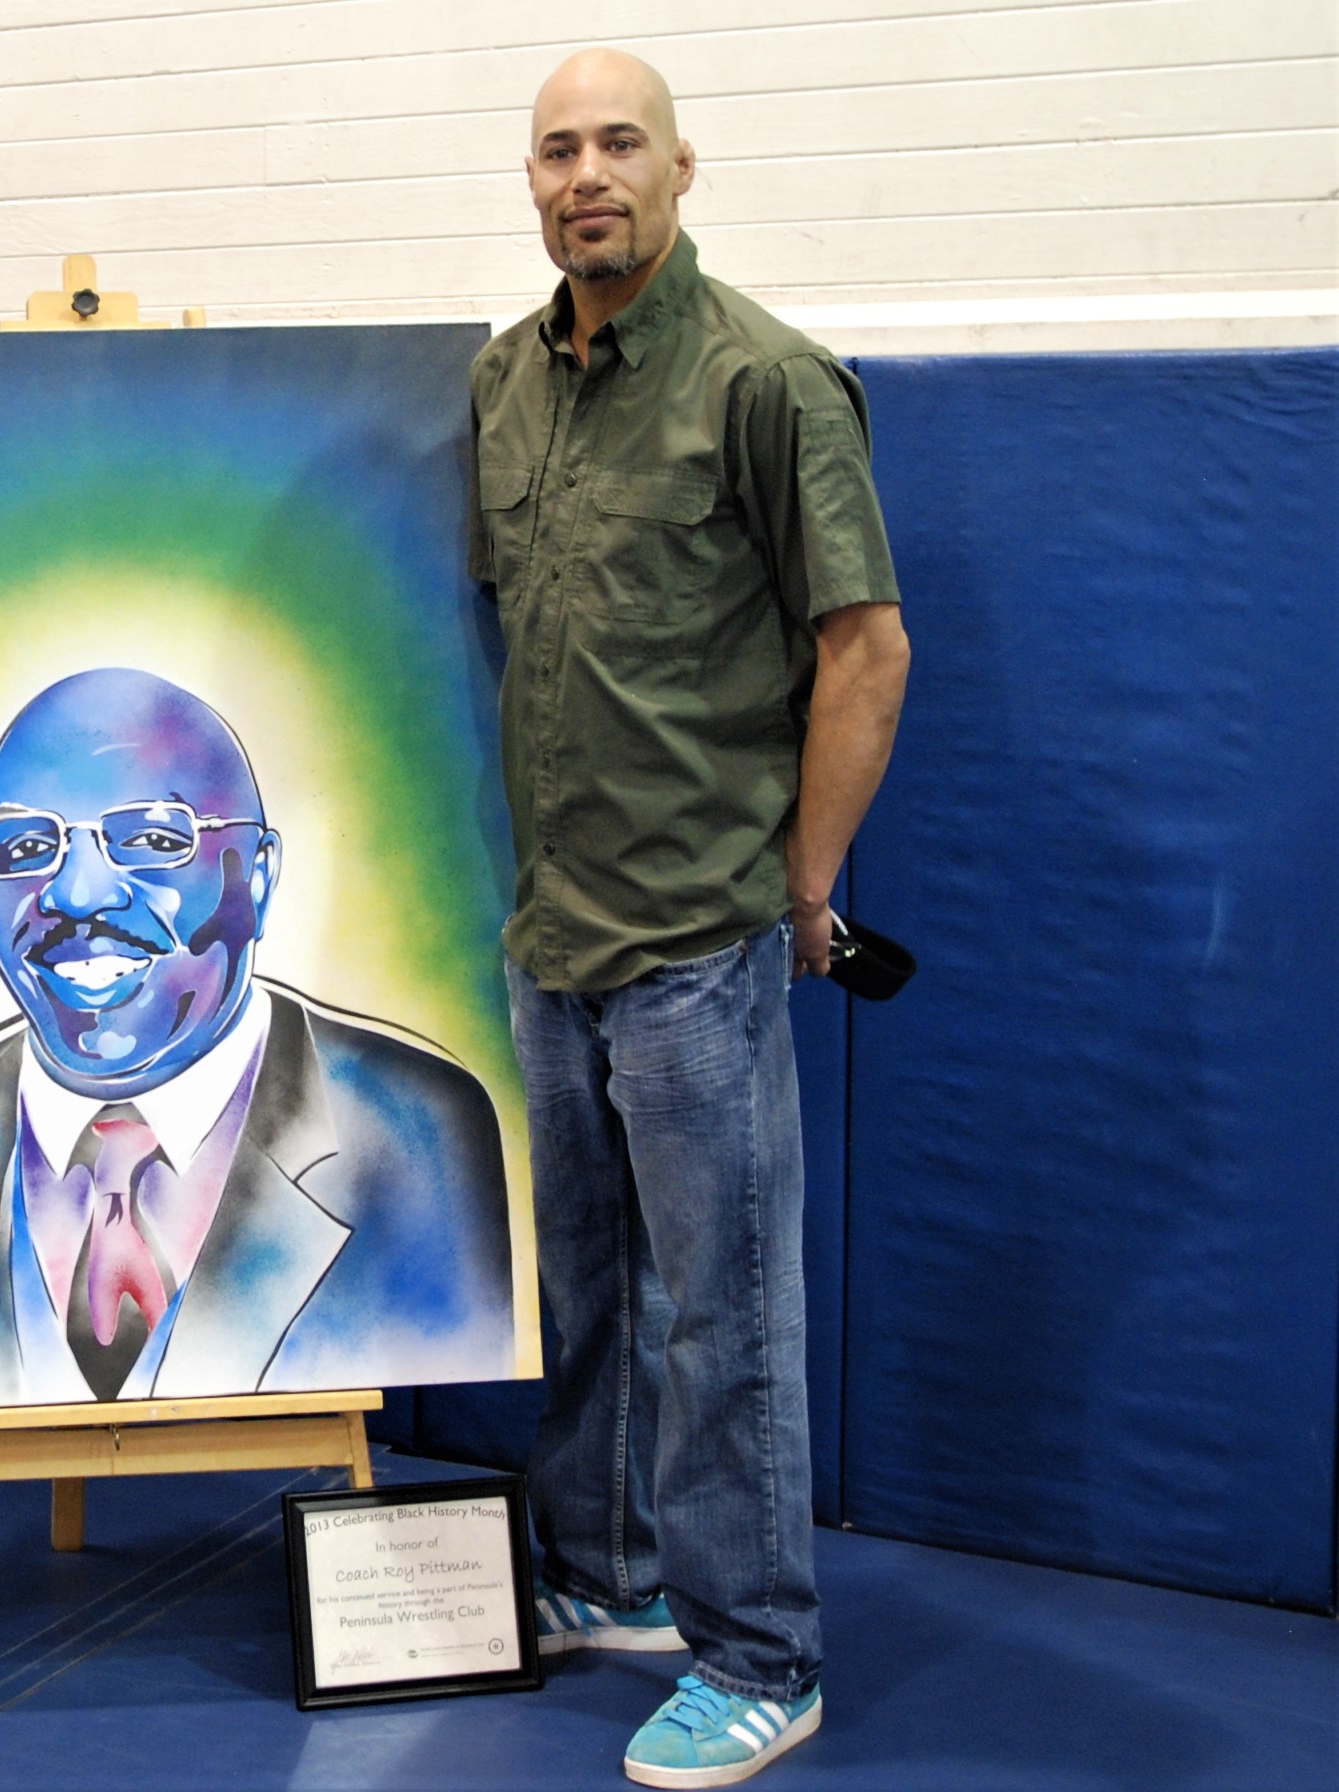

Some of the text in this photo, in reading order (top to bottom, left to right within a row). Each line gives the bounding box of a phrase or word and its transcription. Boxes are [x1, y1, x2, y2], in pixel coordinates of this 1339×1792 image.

[304, 1505, 506, 1537] 2013 Celebrating Black History Month
[375, 1536, 439, 1553] In honor of
[335, 1559, 483, 1584] Coach Roy Pittman
[339, 1604, 486, 1629] Peninsula Wrestling Club
